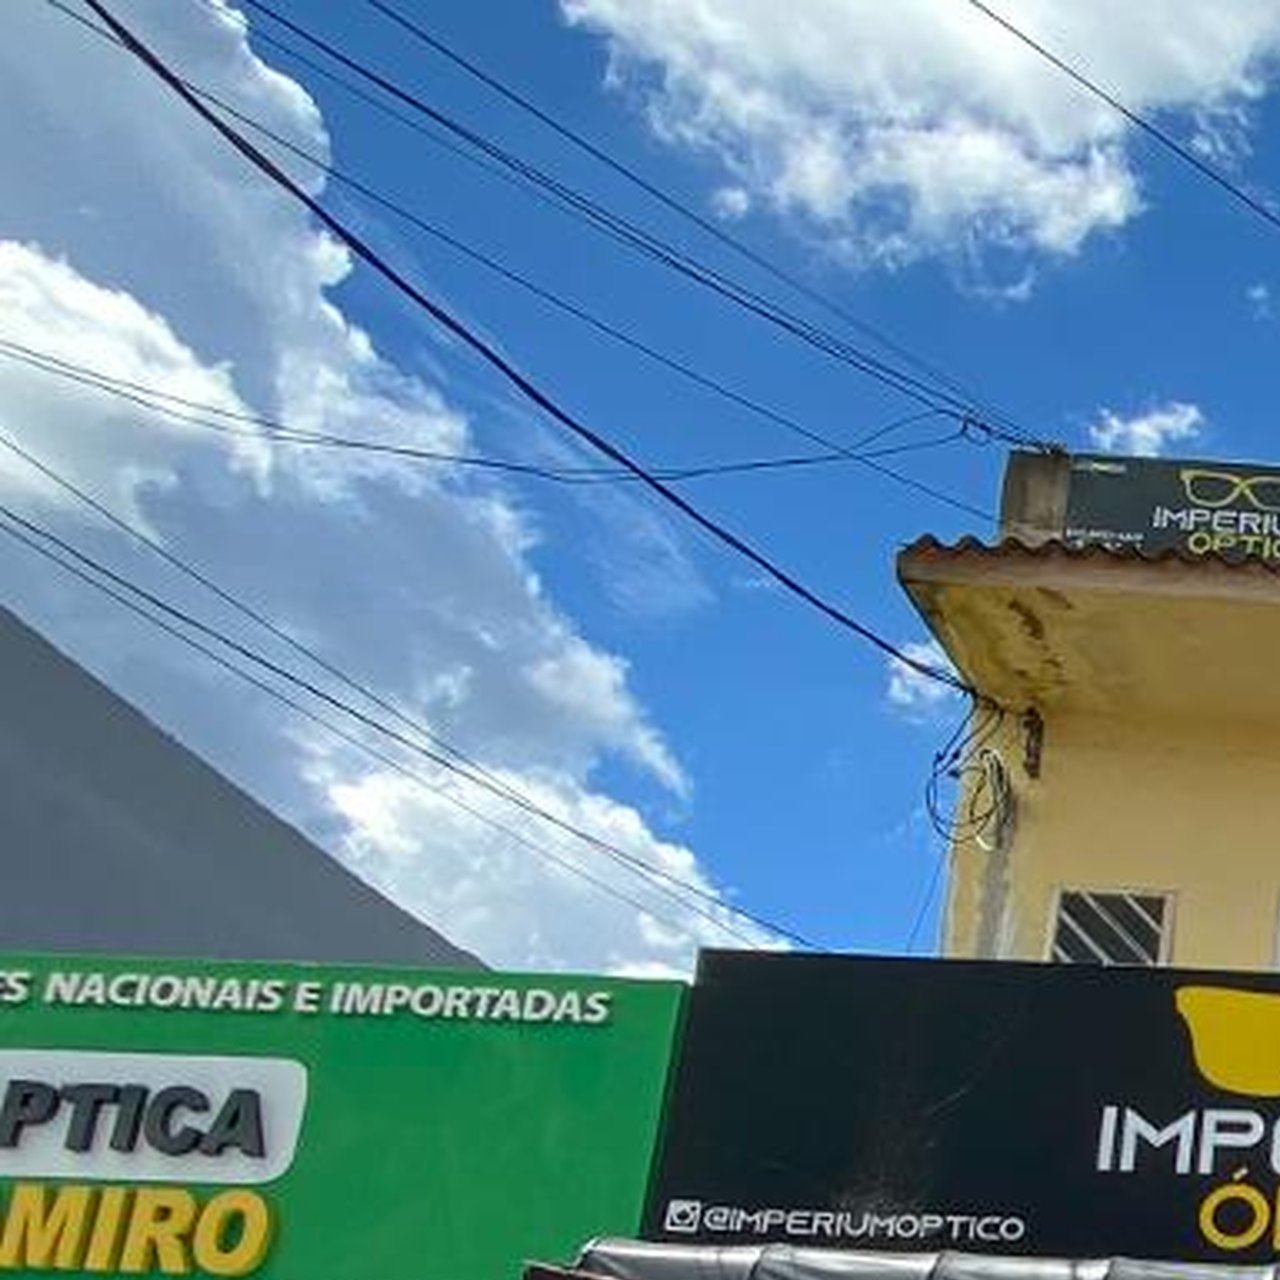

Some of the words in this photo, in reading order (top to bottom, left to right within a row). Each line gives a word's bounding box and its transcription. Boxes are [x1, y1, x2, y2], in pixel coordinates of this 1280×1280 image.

[45, 973, 283, 1012] NACIONAIS
[294, 981, 320, 1013] E
[331, 981, 610, 1024] IMPORTADAS
[0, 1079, 267, 1158] PTICA
[0, 1182, 272, 1278] MIRO
[704, 1207, 1026, 1242] @IMPERIUMOPTICO
